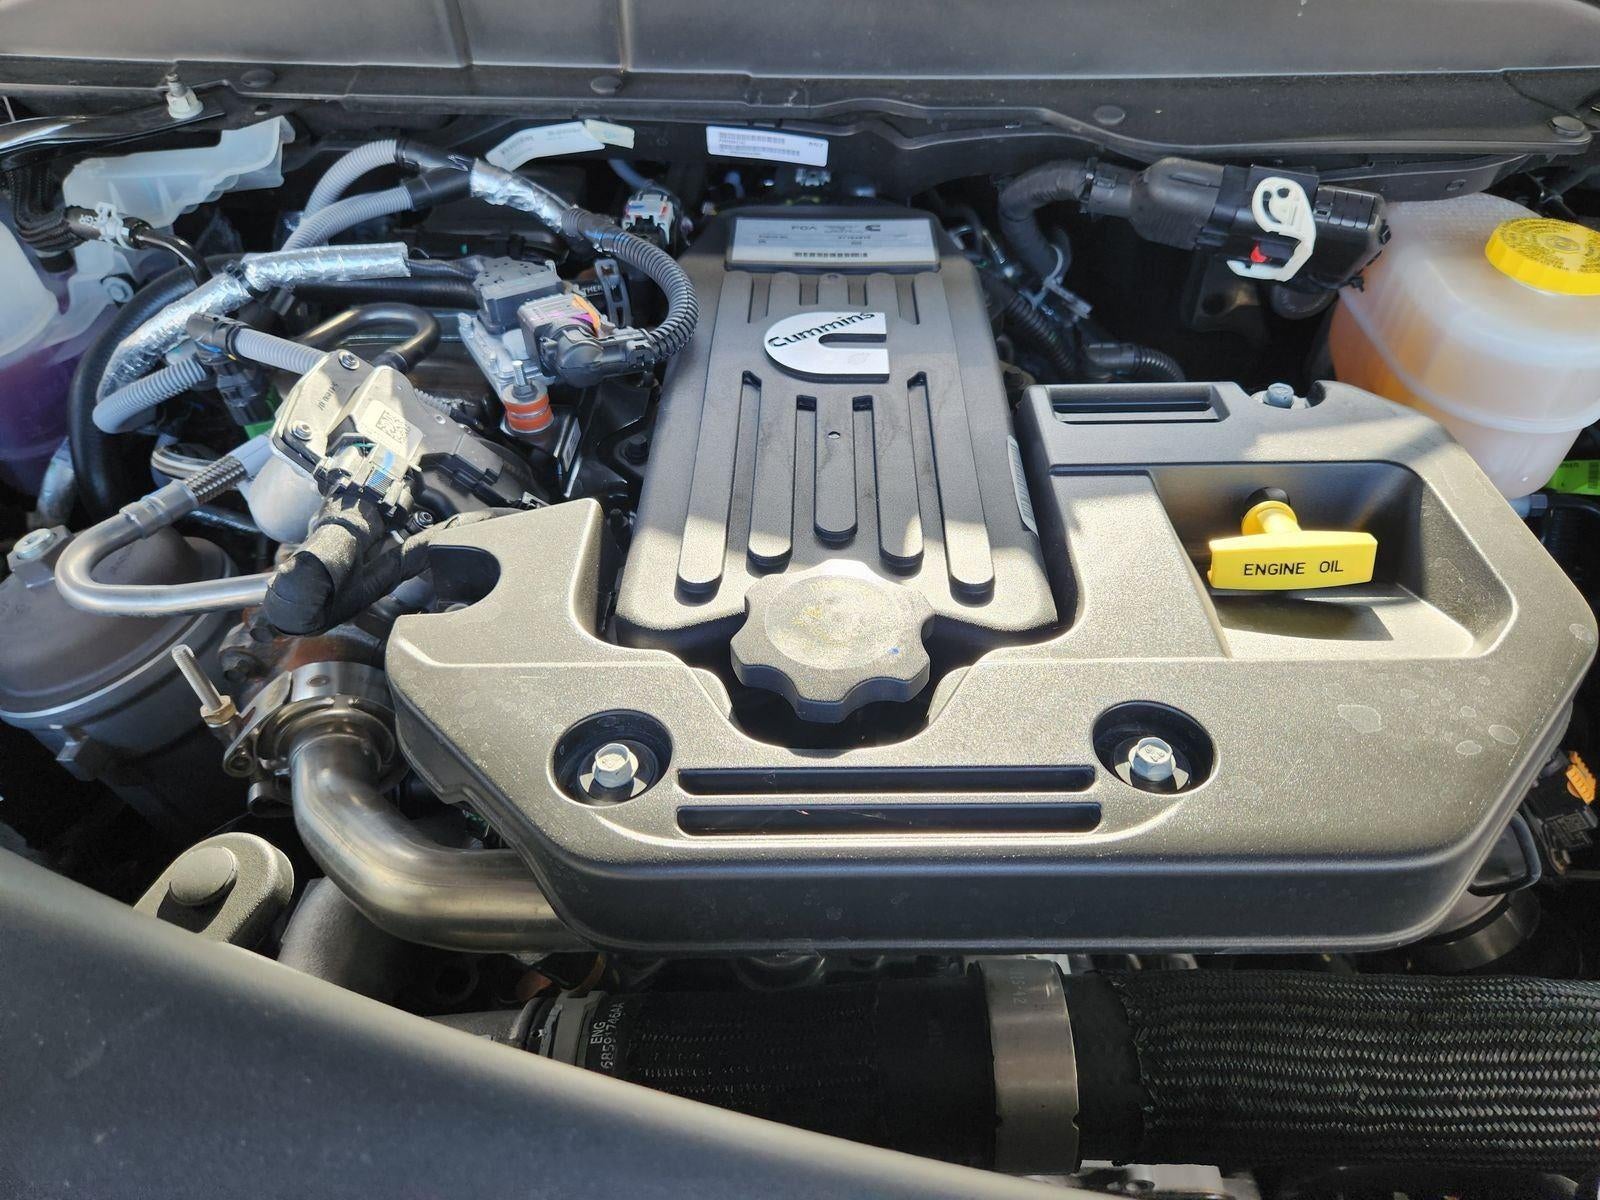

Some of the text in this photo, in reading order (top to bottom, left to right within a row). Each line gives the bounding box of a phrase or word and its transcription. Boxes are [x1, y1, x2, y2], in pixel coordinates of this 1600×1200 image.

[768, 313, 875, 347] Cummins
[1243, 560, 1344, 576] ENGINE OIL
[590, 1021, 606, 1044] ENG
